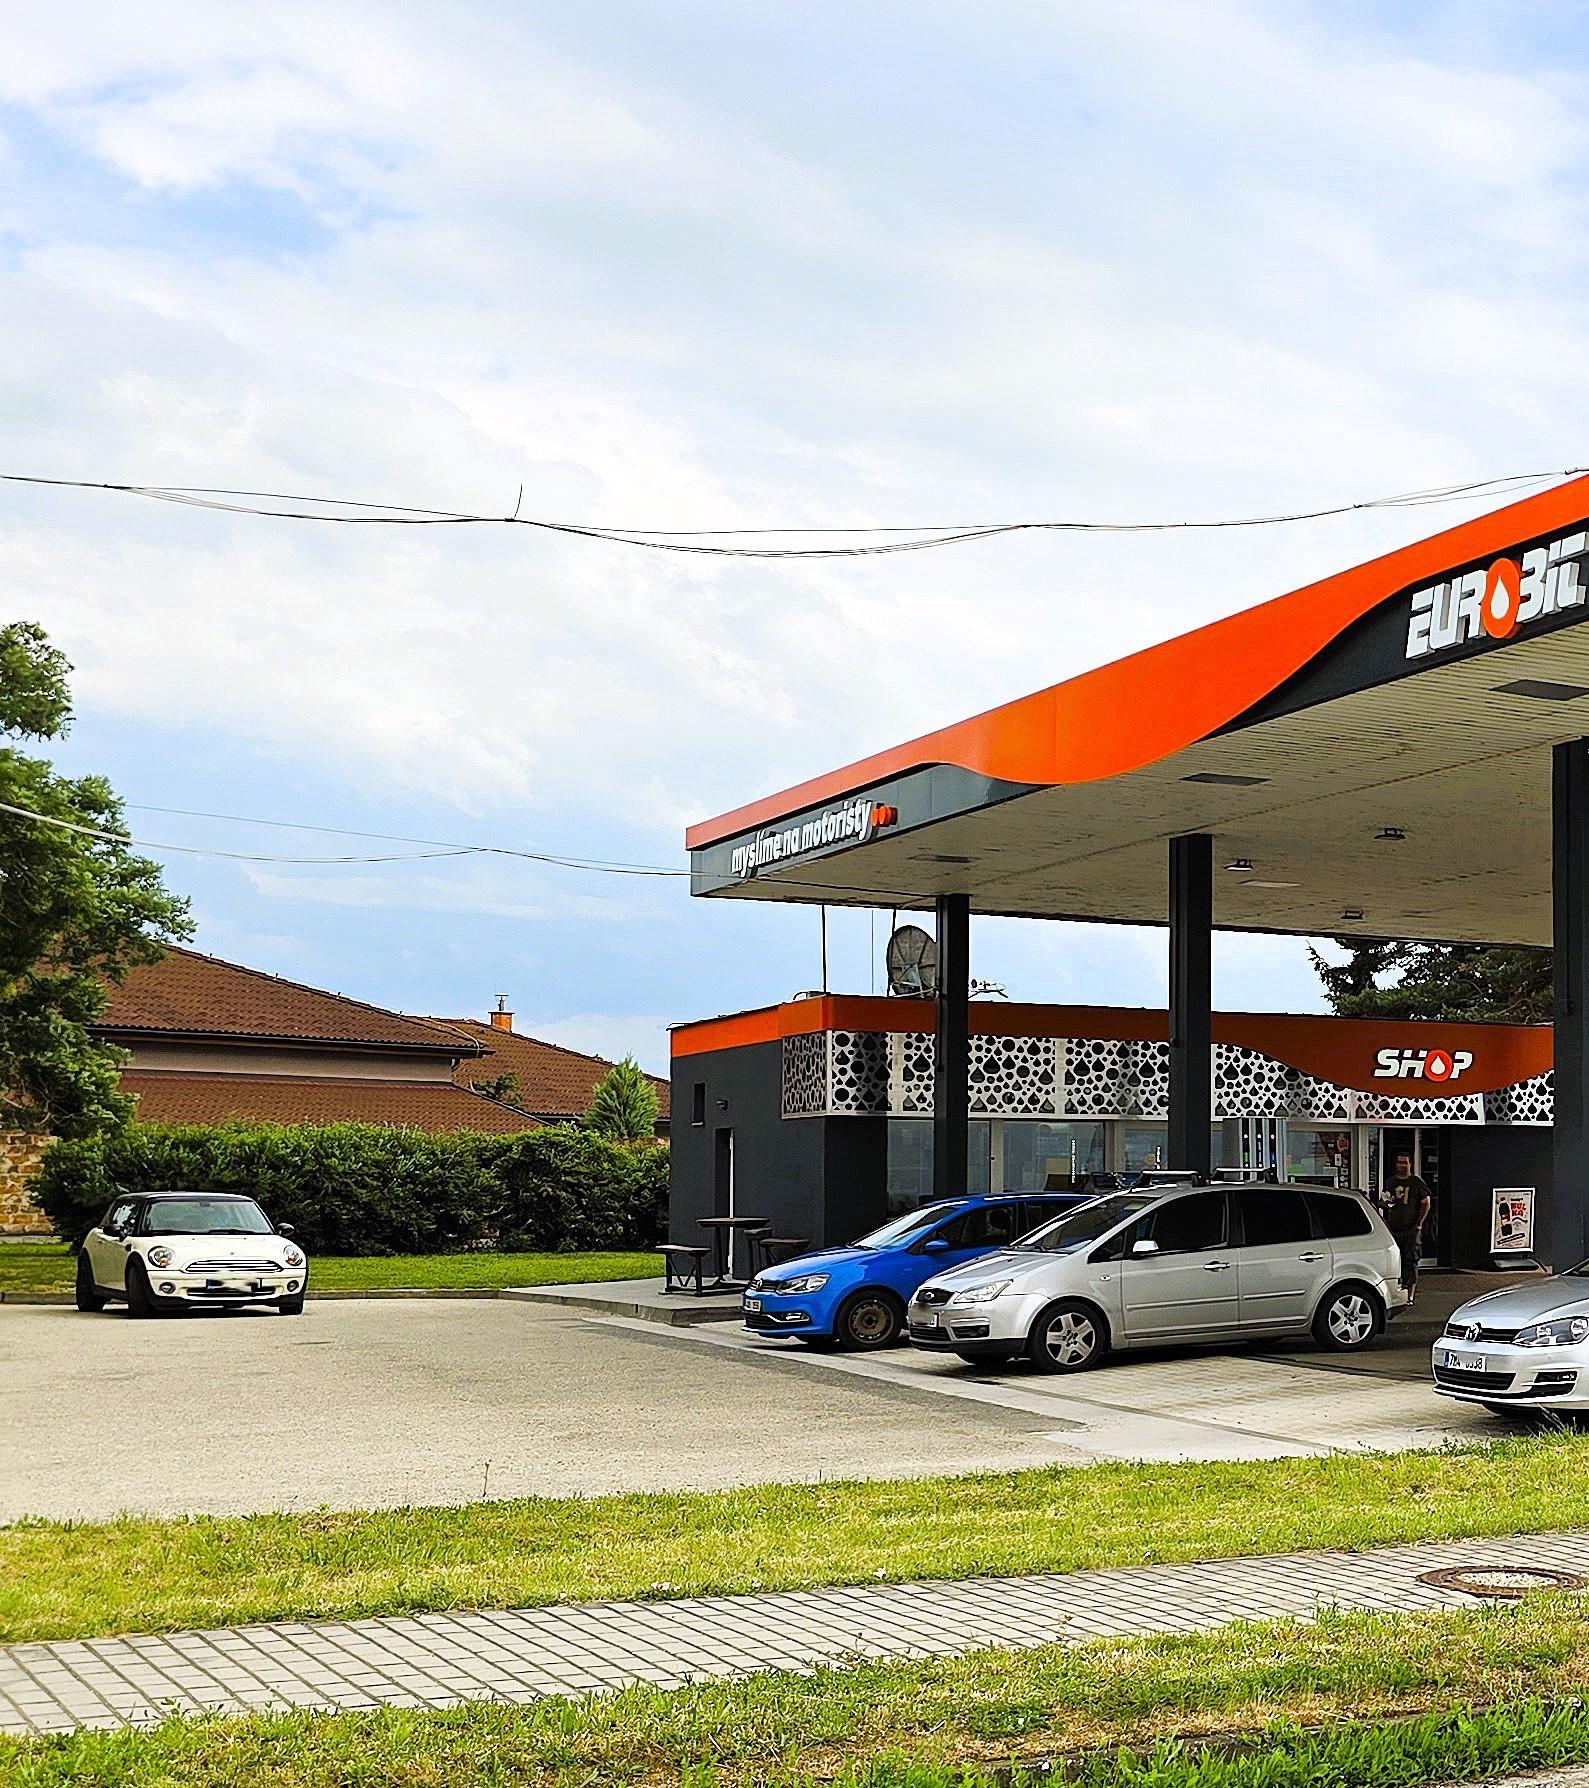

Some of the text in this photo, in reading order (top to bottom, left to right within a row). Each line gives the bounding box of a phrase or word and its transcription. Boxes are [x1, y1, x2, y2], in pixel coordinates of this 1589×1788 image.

[731, 800, 872, 877] myslíme na motoristy
[1373, 1049, 1473, 1082] SHOP
